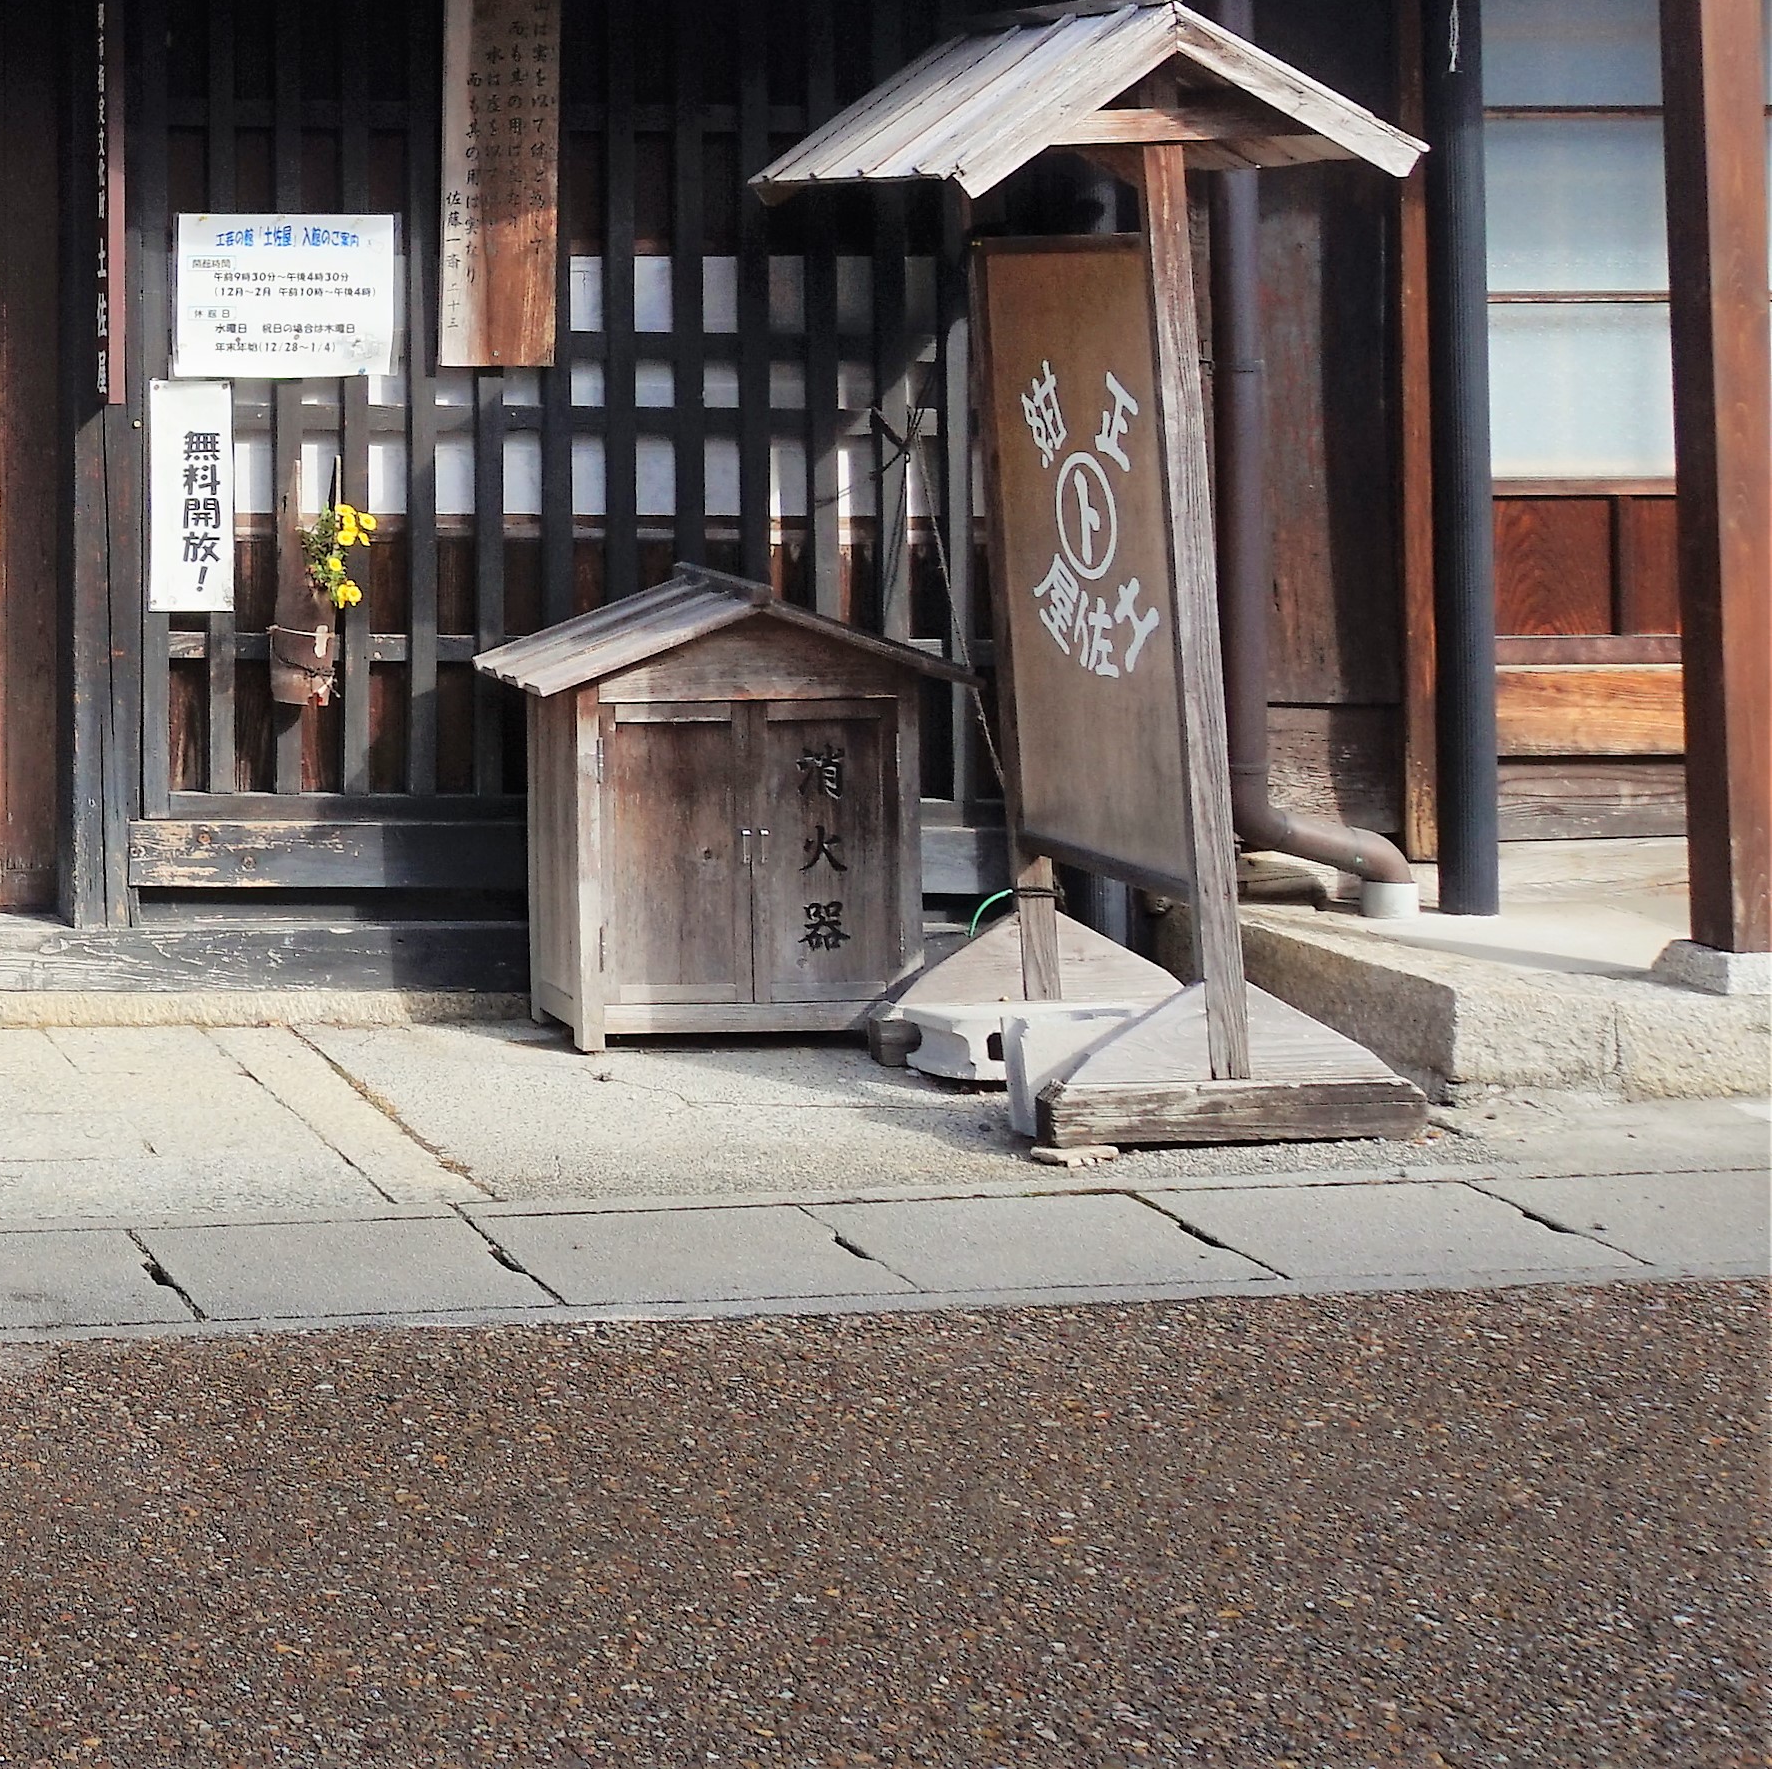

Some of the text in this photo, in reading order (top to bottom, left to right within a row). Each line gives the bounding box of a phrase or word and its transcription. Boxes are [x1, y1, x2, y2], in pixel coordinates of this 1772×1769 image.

[215, 323, 248, 334] 水曜日
[182, 431, 221, 592] 無料開放！
[796, 743, 851, 951] 消火器
